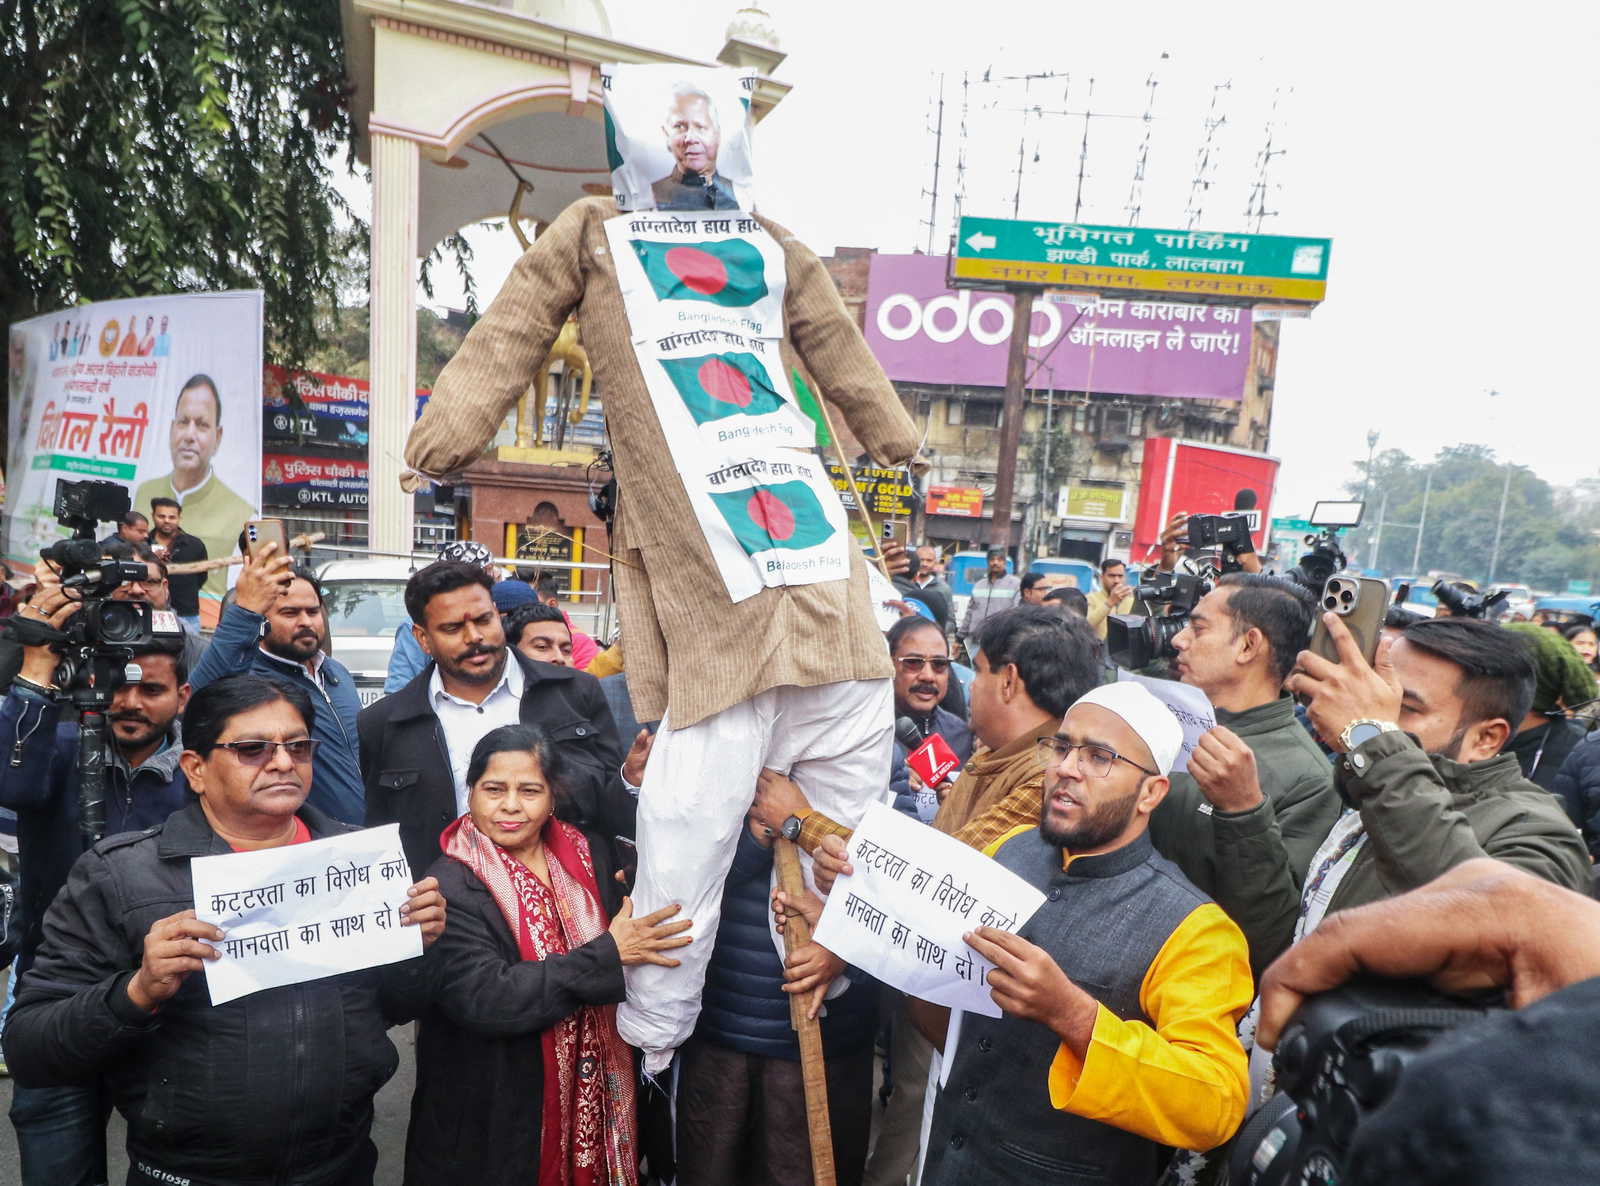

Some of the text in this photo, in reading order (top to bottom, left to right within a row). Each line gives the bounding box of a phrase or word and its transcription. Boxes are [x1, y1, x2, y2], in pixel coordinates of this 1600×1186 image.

[629, 216, 697, 234] बांग्लादेश
[702, 219, 731, 234] हाय
[1032, 224, 1250, 253] भूमिगत पार्किंग
[991, 266, 1049, 280] नगर
[1044, 246, 1098, 265] झण्डी
[1164, 255, 1245, 274] लालबाग
[877, 288, 1062, 349] odoo
[1068, 321, 1161, 352] ऑनलाइन
[1166, 324, 1185, 351] ले
[99, 397, 149, 459] रैली
[312, 492, 334, 503] KTL
[878, 482, 912, 497] GOLD
[294, 876, 316, 897] का
[325, 861, 371, 893] विरोध
[379, 851, 409, 881] करो
[910, 867, 934, 895] का
[931, 873, 978, 920] विरोध
[979, 905, 1018, 934] करो
[223, 929, 290, 960] मानवता
[298, 922, 321, 945] का
[330, 913, 366, 939] साथ
[374, 902, 392, 929] दो
[844, 891, 889, 936] मानवता
[891, 920, 911, 950] का
[915, 934, 947, 971] साथ
[955, 951, 974, 981] दो
